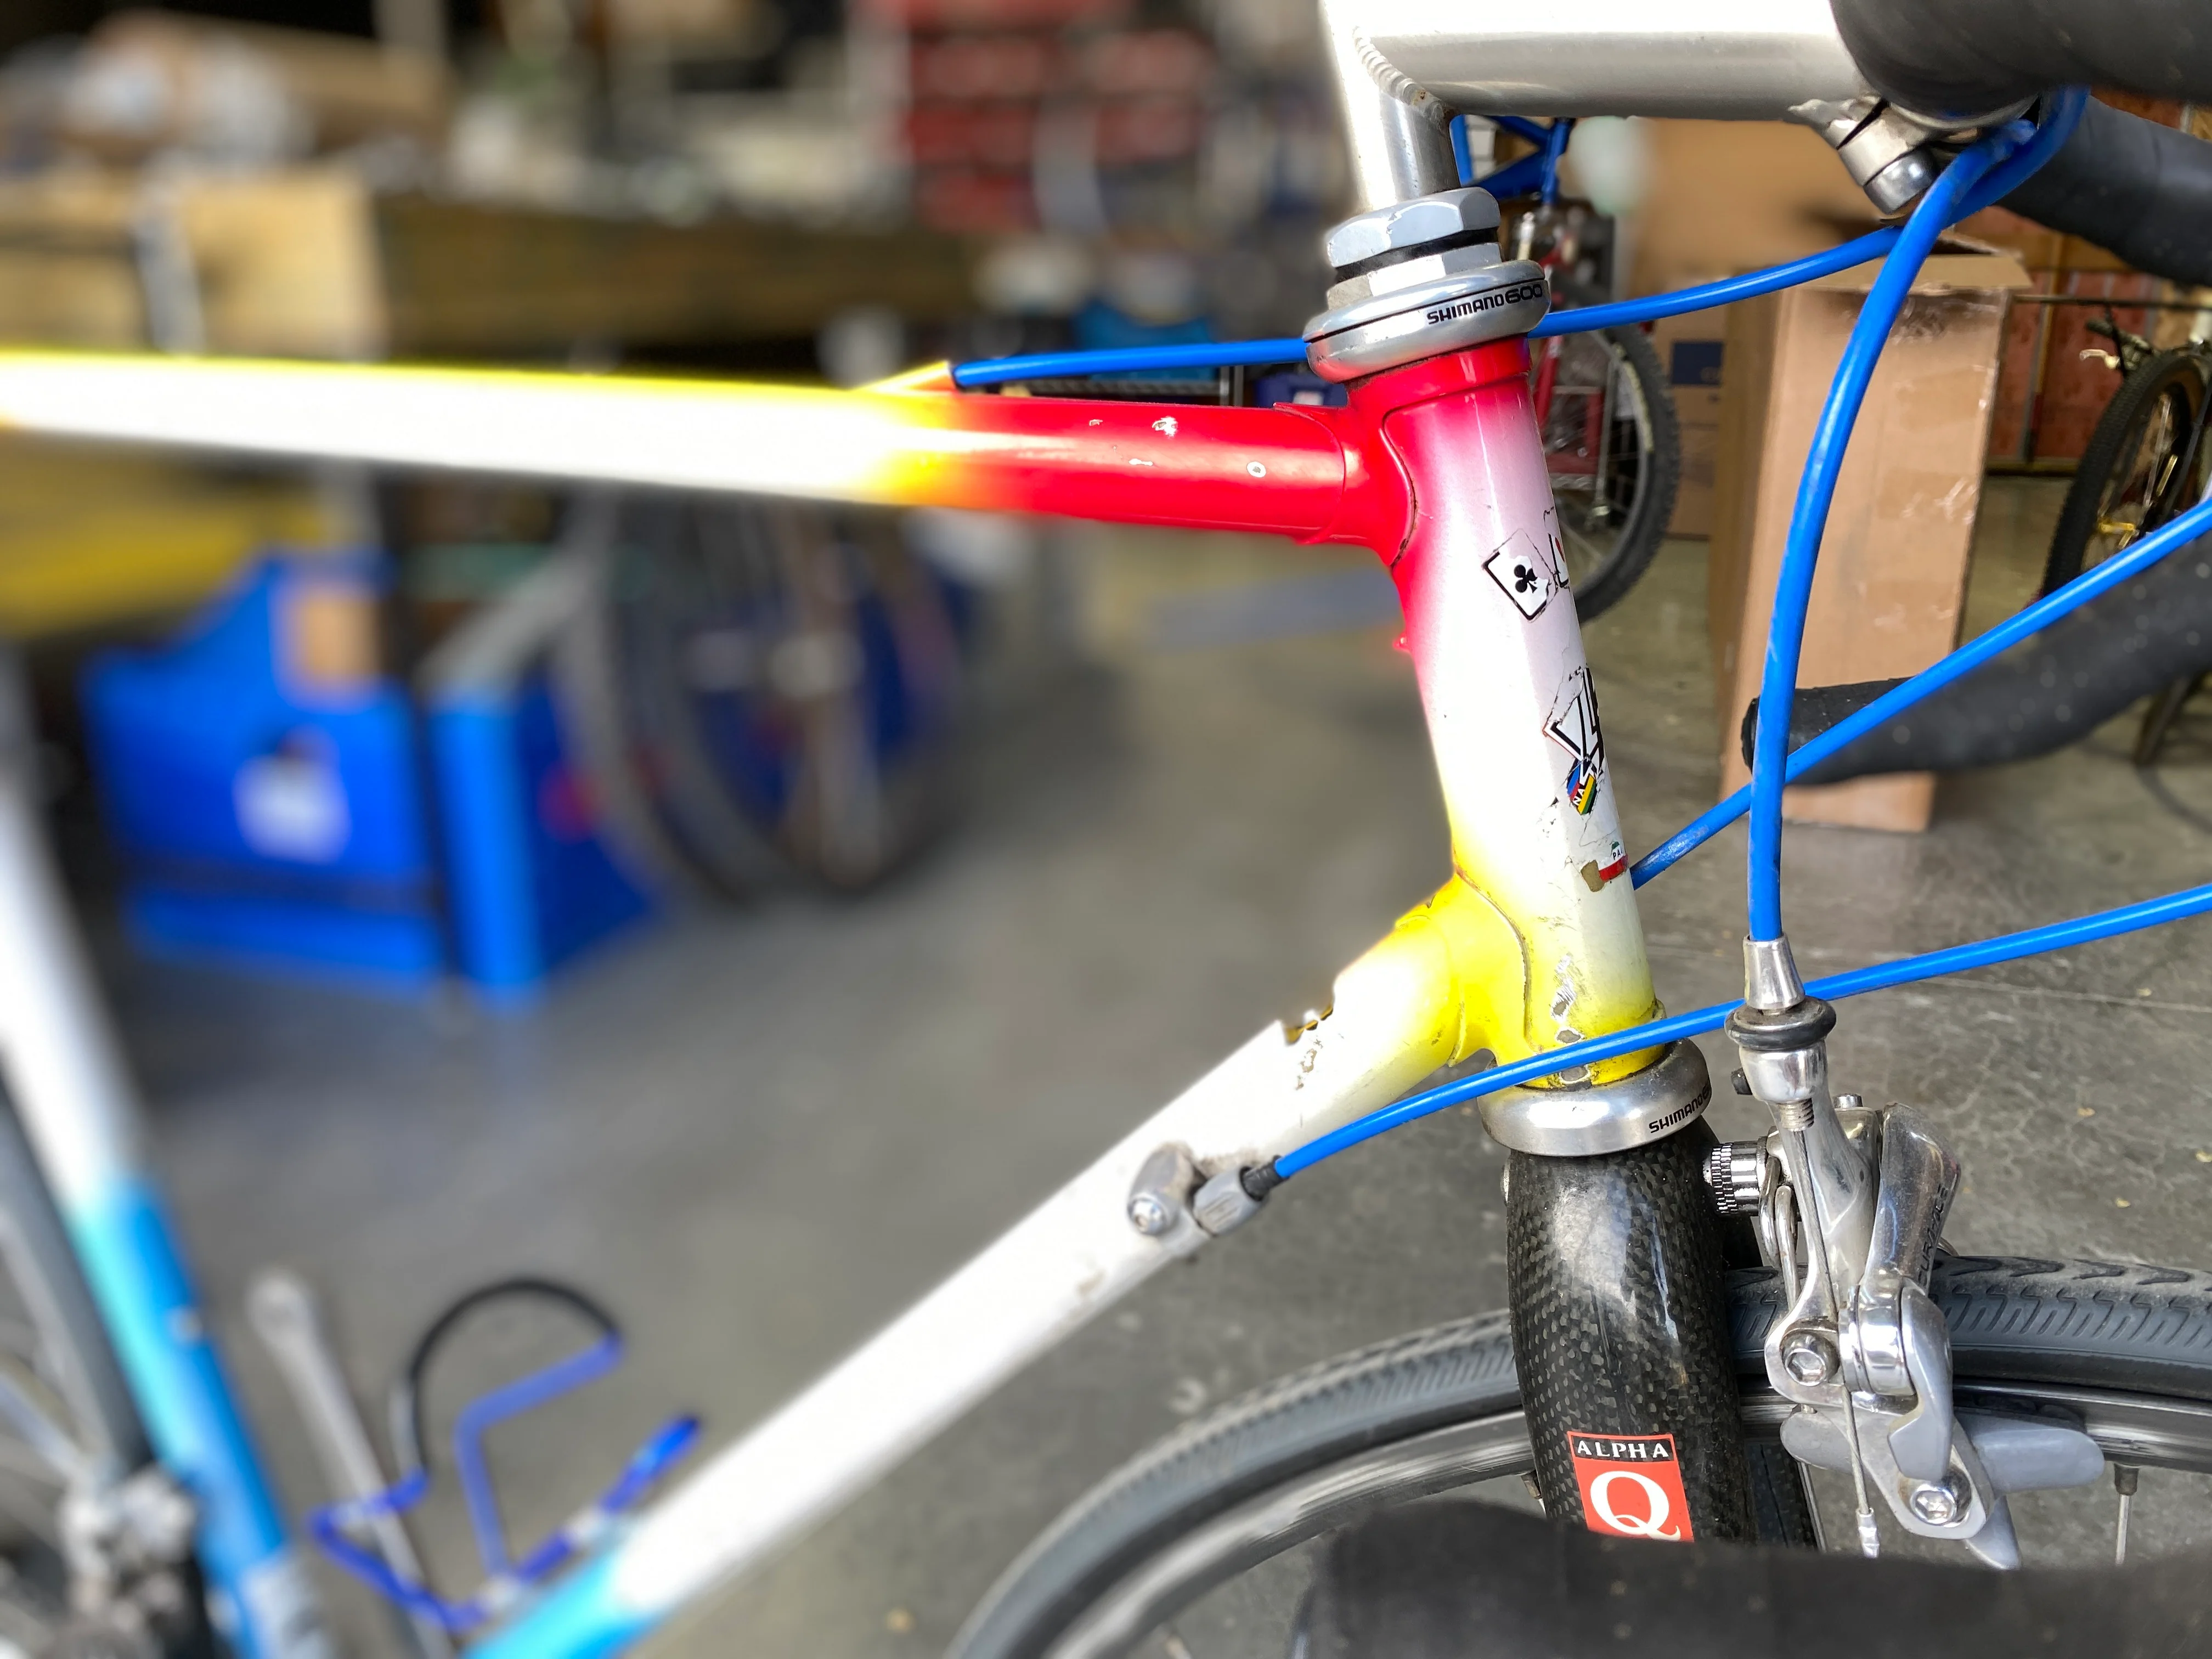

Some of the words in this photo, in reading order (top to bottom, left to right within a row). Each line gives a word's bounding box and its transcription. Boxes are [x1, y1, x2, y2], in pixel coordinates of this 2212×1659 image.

[1426, 293, 1505, 325] SHIMANO
[1649, 1093, 1703, 1134] SHIMANO
[1577, 1440, 1669, 1458] ALPHA
[1590, 1470, 1681, 1542] Q
